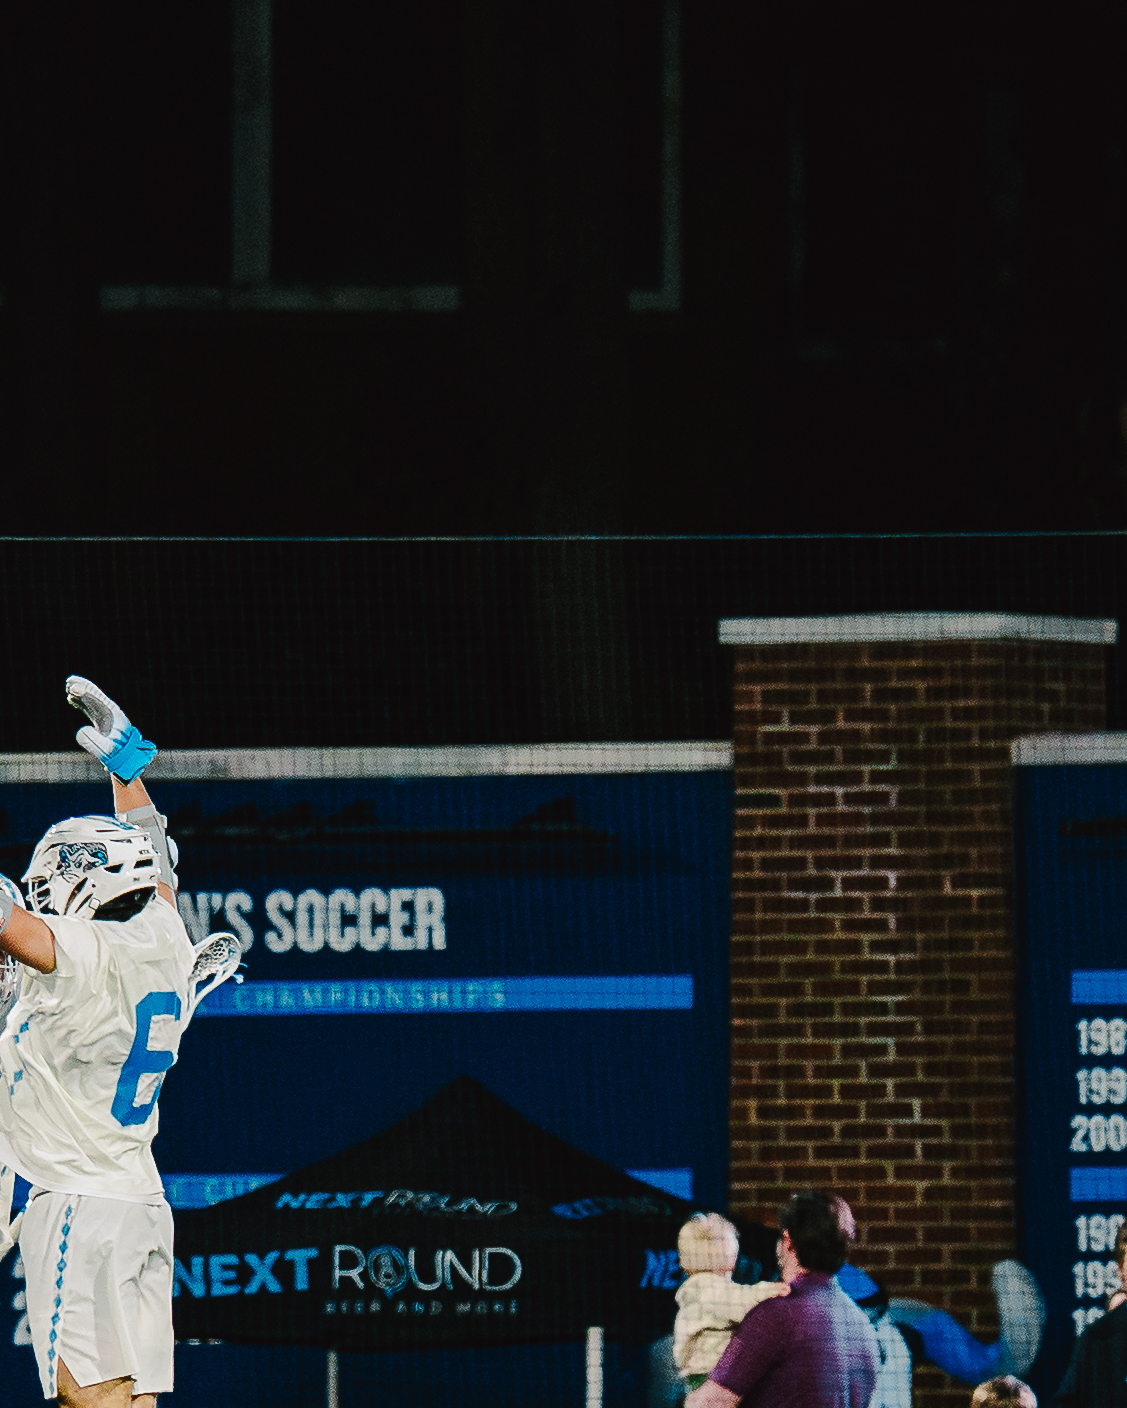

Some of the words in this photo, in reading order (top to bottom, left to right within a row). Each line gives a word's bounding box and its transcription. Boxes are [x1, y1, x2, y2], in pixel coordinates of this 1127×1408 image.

[264, 887, 447, 953] SOCCER
[232, 979, 507, 1011] CHAMPIONSHIPS
[111, 991, 182, 1127] 6
[173, 1247, 320, 1298] NEXT
[331, 1244, 523, 1299] ROUND
